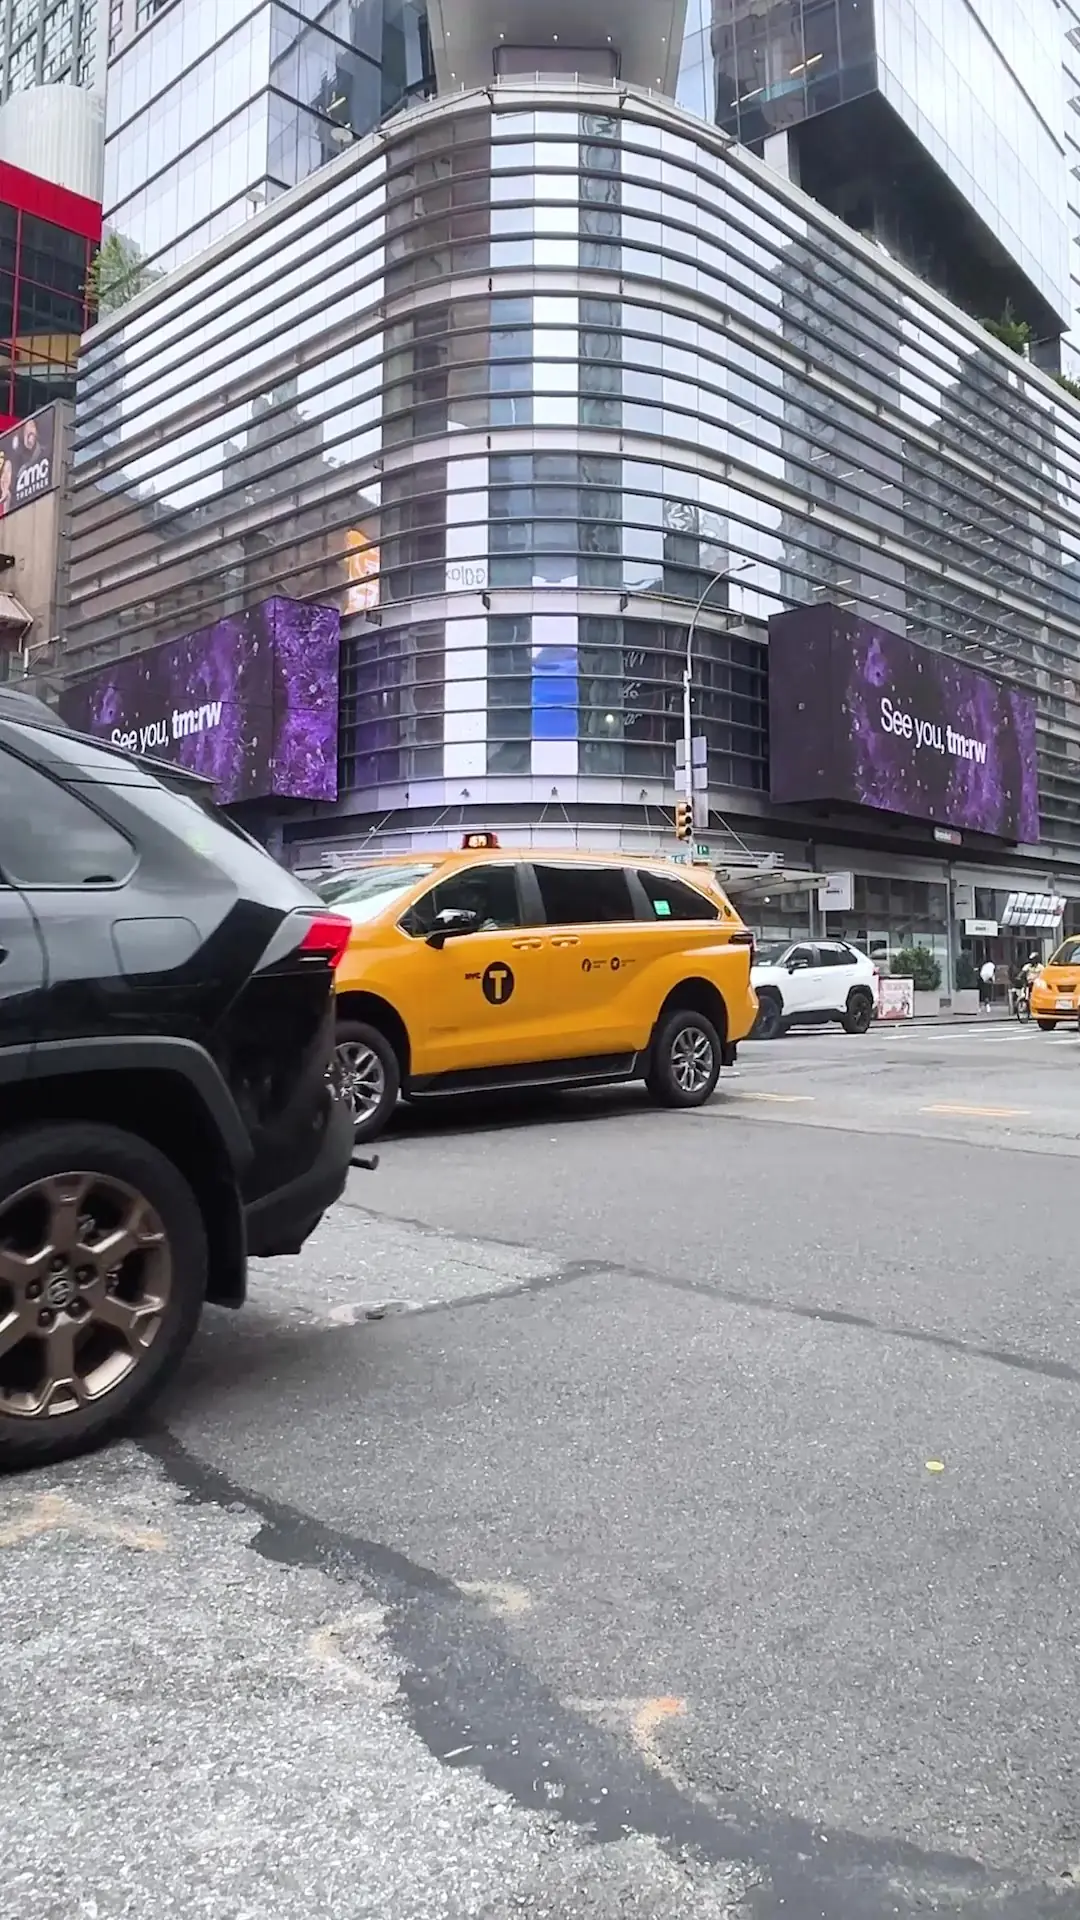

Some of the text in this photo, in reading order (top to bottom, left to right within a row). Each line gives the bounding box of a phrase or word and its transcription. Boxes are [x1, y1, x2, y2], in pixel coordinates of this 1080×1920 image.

[16, 458, 49, 491] amc
[111, 701, 222, 754] See you, tm:rw
[880, 697, 987, 764] See you, tm:rw
[488, 970, 508, 1000] T
